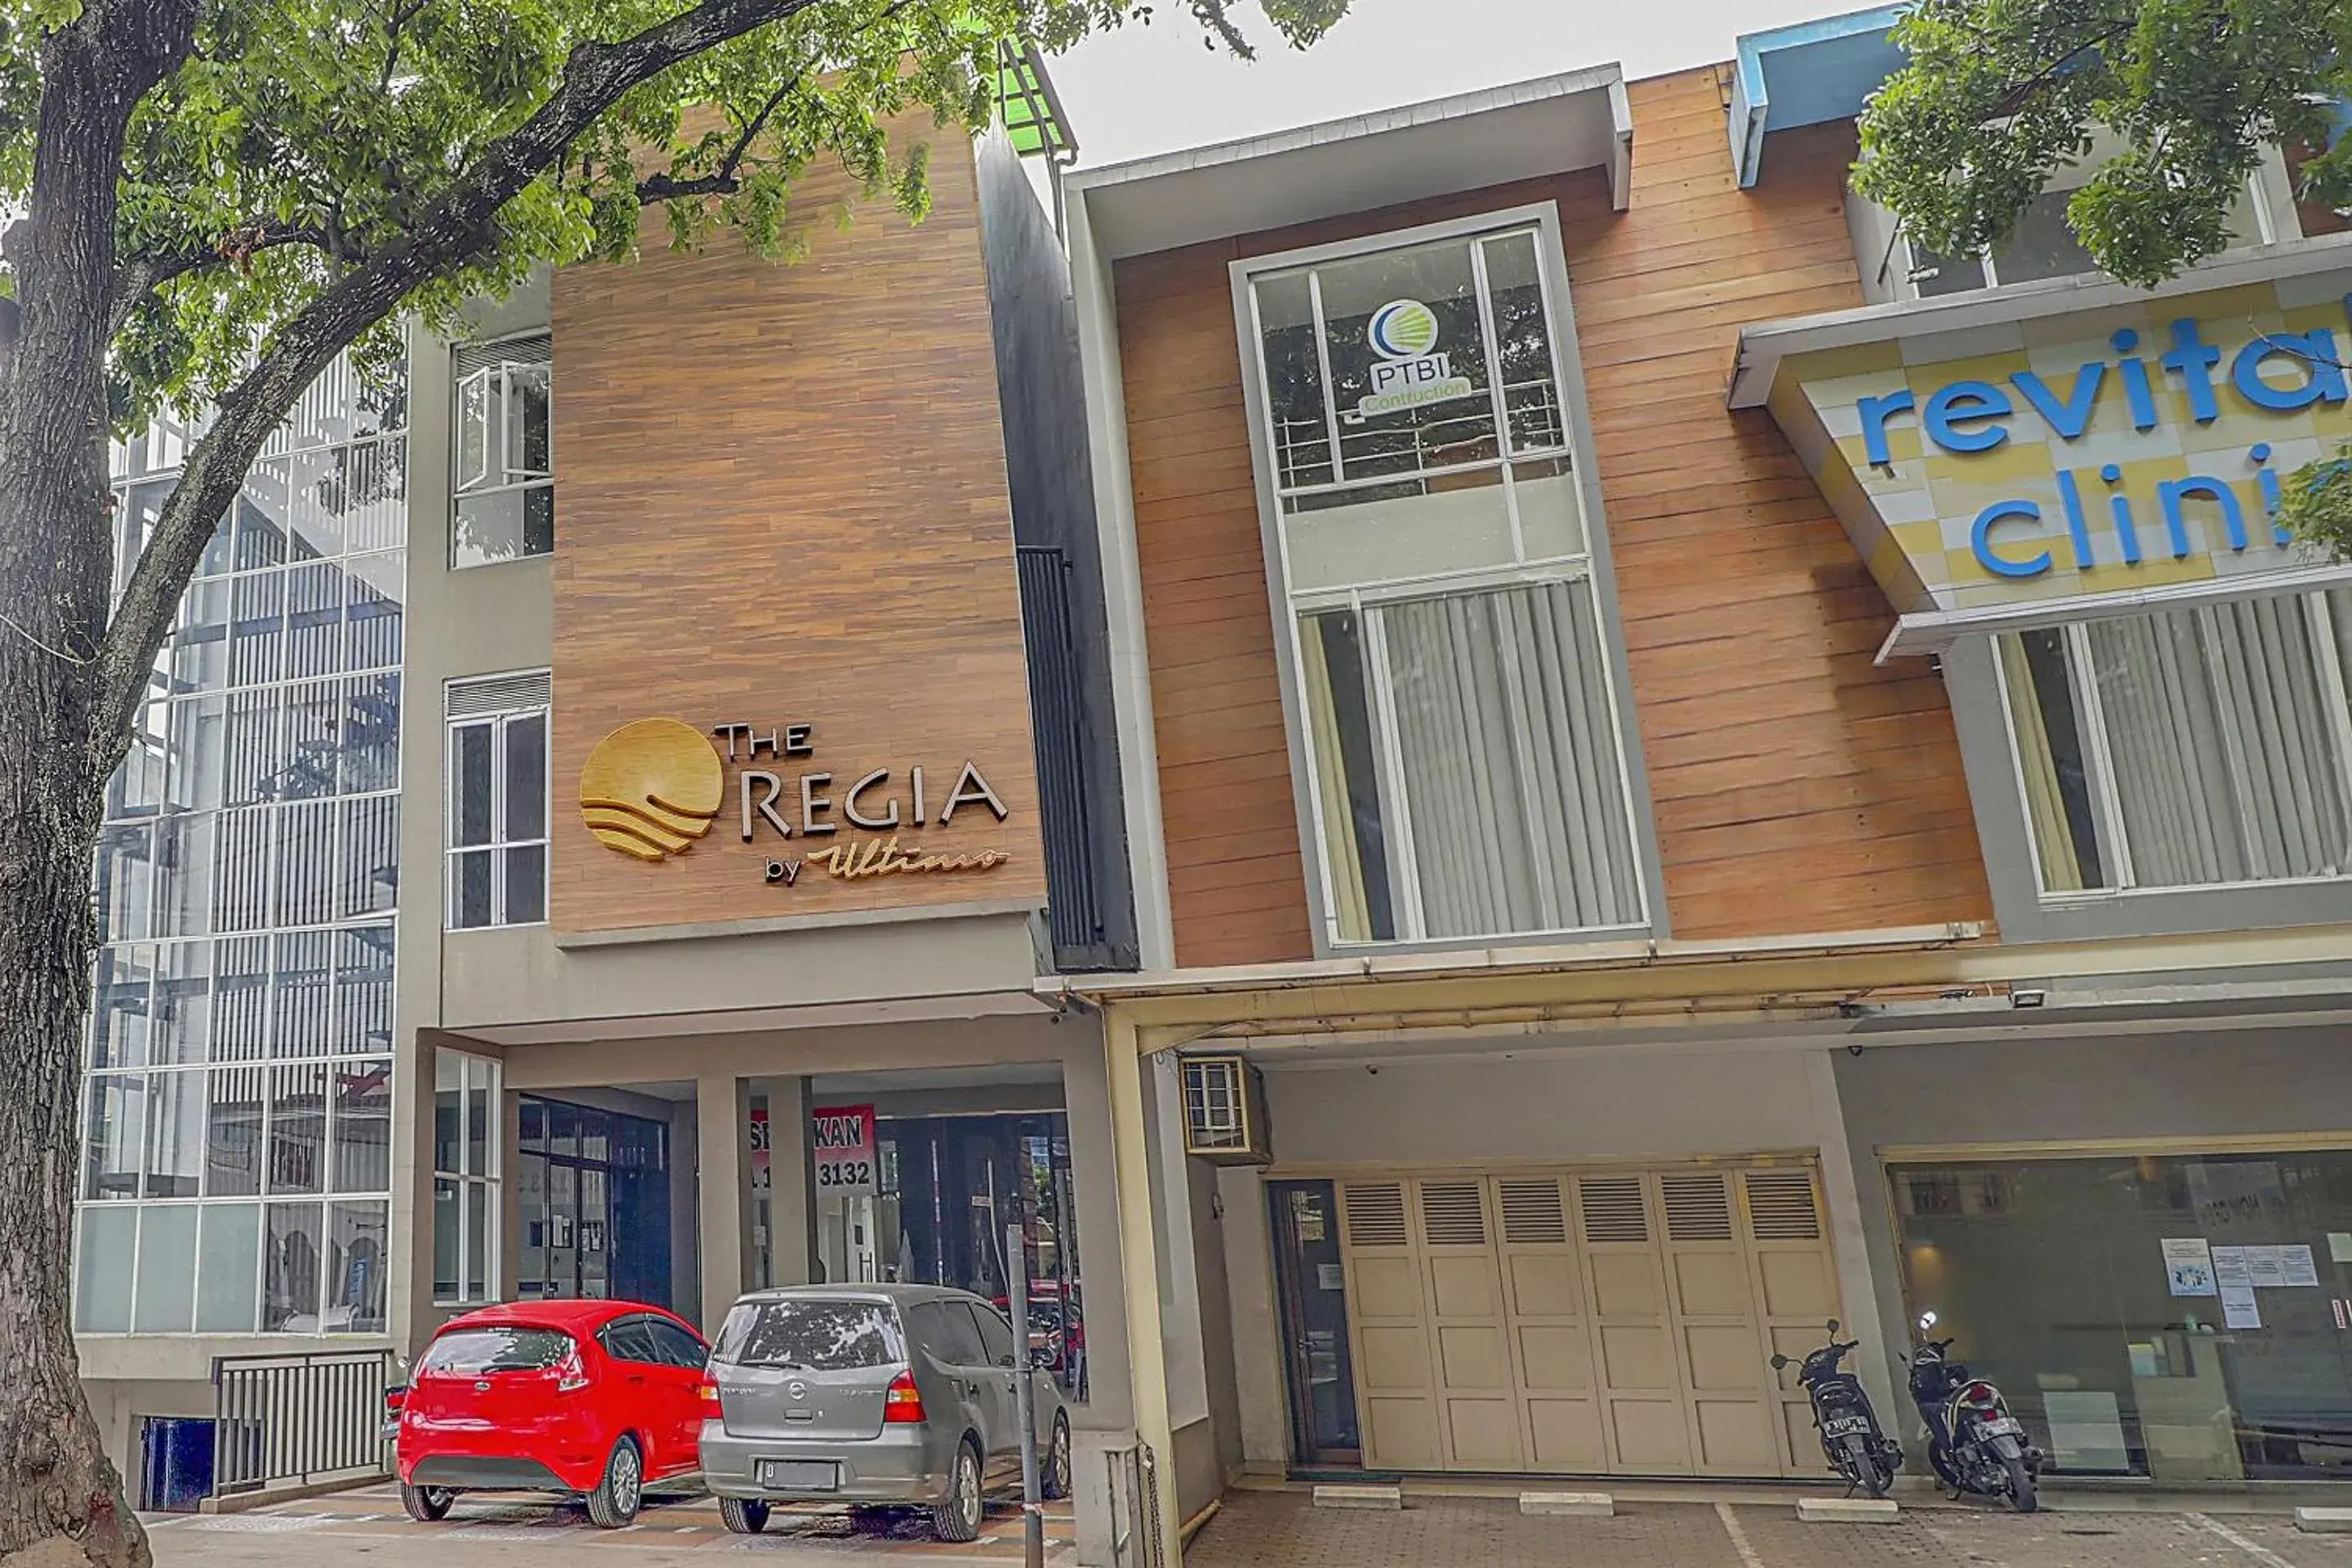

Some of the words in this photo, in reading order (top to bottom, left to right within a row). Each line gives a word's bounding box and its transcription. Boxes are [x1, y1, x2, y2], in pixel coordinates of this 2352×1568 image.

[1377, 357, 1445, 390] PTBI
[1856, 292, 2352, 467] revita
[1971, 442, 2352, 577] clini
[713, 722, 813, 761] THE
[740, 760, 1009, 842] REGIA
[764, 856, 802, 885] by
[819, 1161, 870, 1187] 3132
